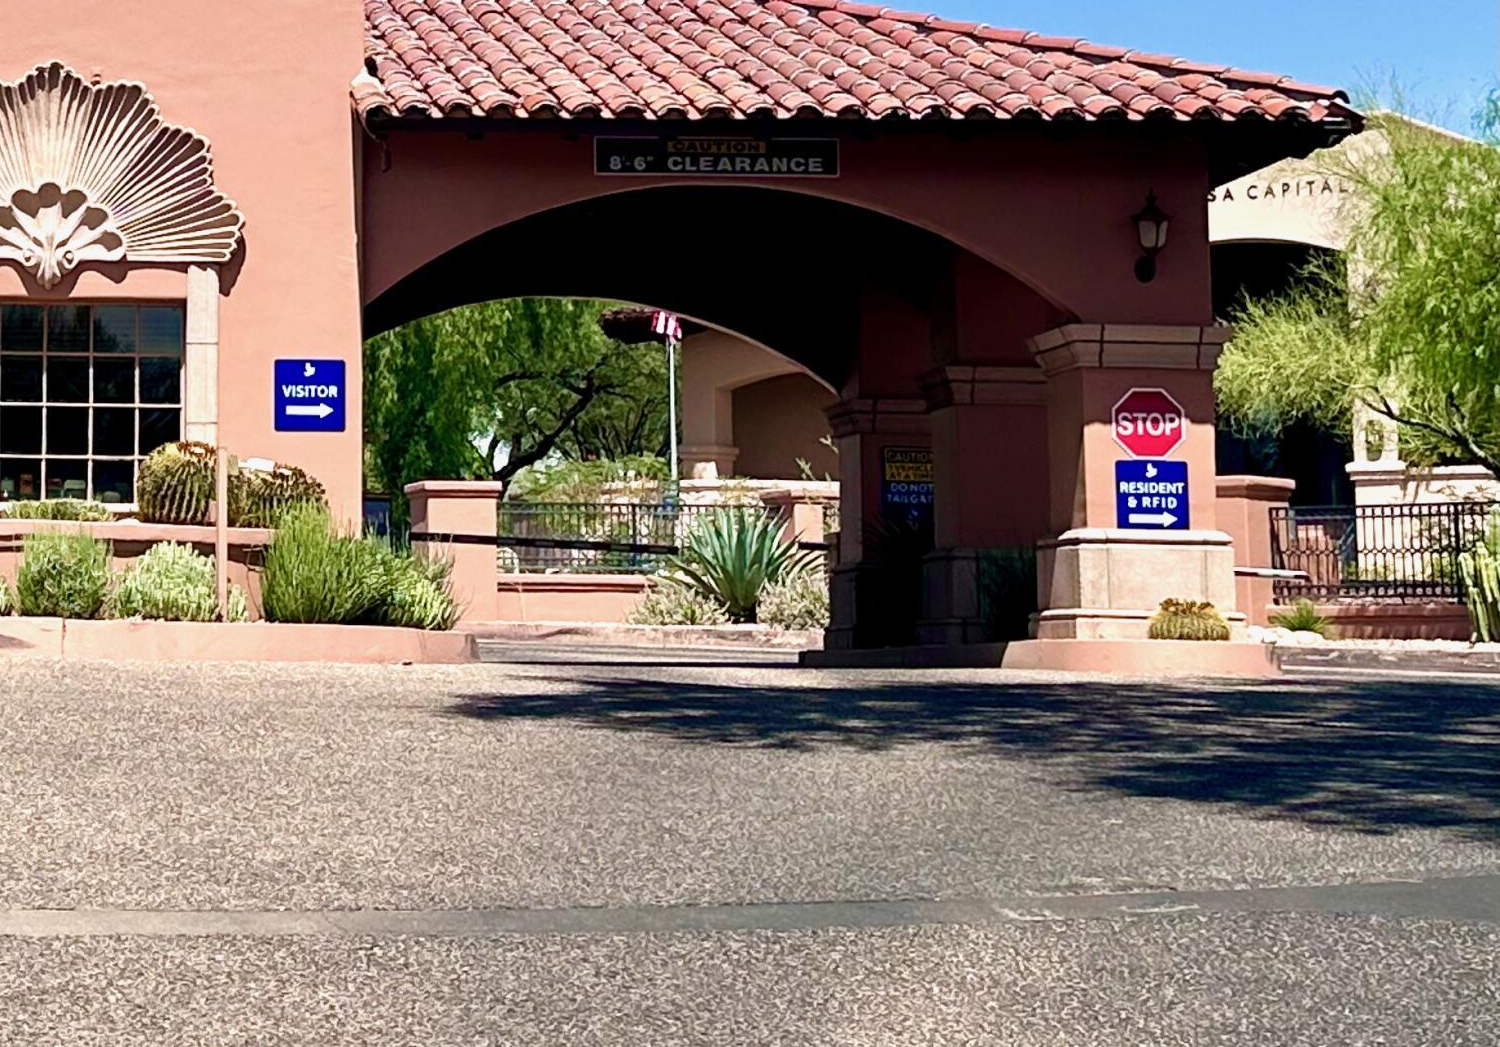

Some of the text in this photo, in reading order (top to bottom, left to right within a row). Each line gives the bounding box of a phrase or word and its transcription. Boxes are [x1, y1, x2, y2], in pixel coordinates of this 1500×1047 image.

[671, 140, 760, 152] CAUTION
[667, 155, 824, 172] CLEARANCE
[1246, 179, 1348, 200] CAPITAL
[281, 384, 338, 398] VISITOR
[1117, 412, 1180, 437] STOP
[890, 482, 934, 494] DO NOT
[1119, 480, 1185, 495] RESIDENT
[887, 494, 933, 505] TAILGAT
[1127, 496, 1178, 509] & RFID
